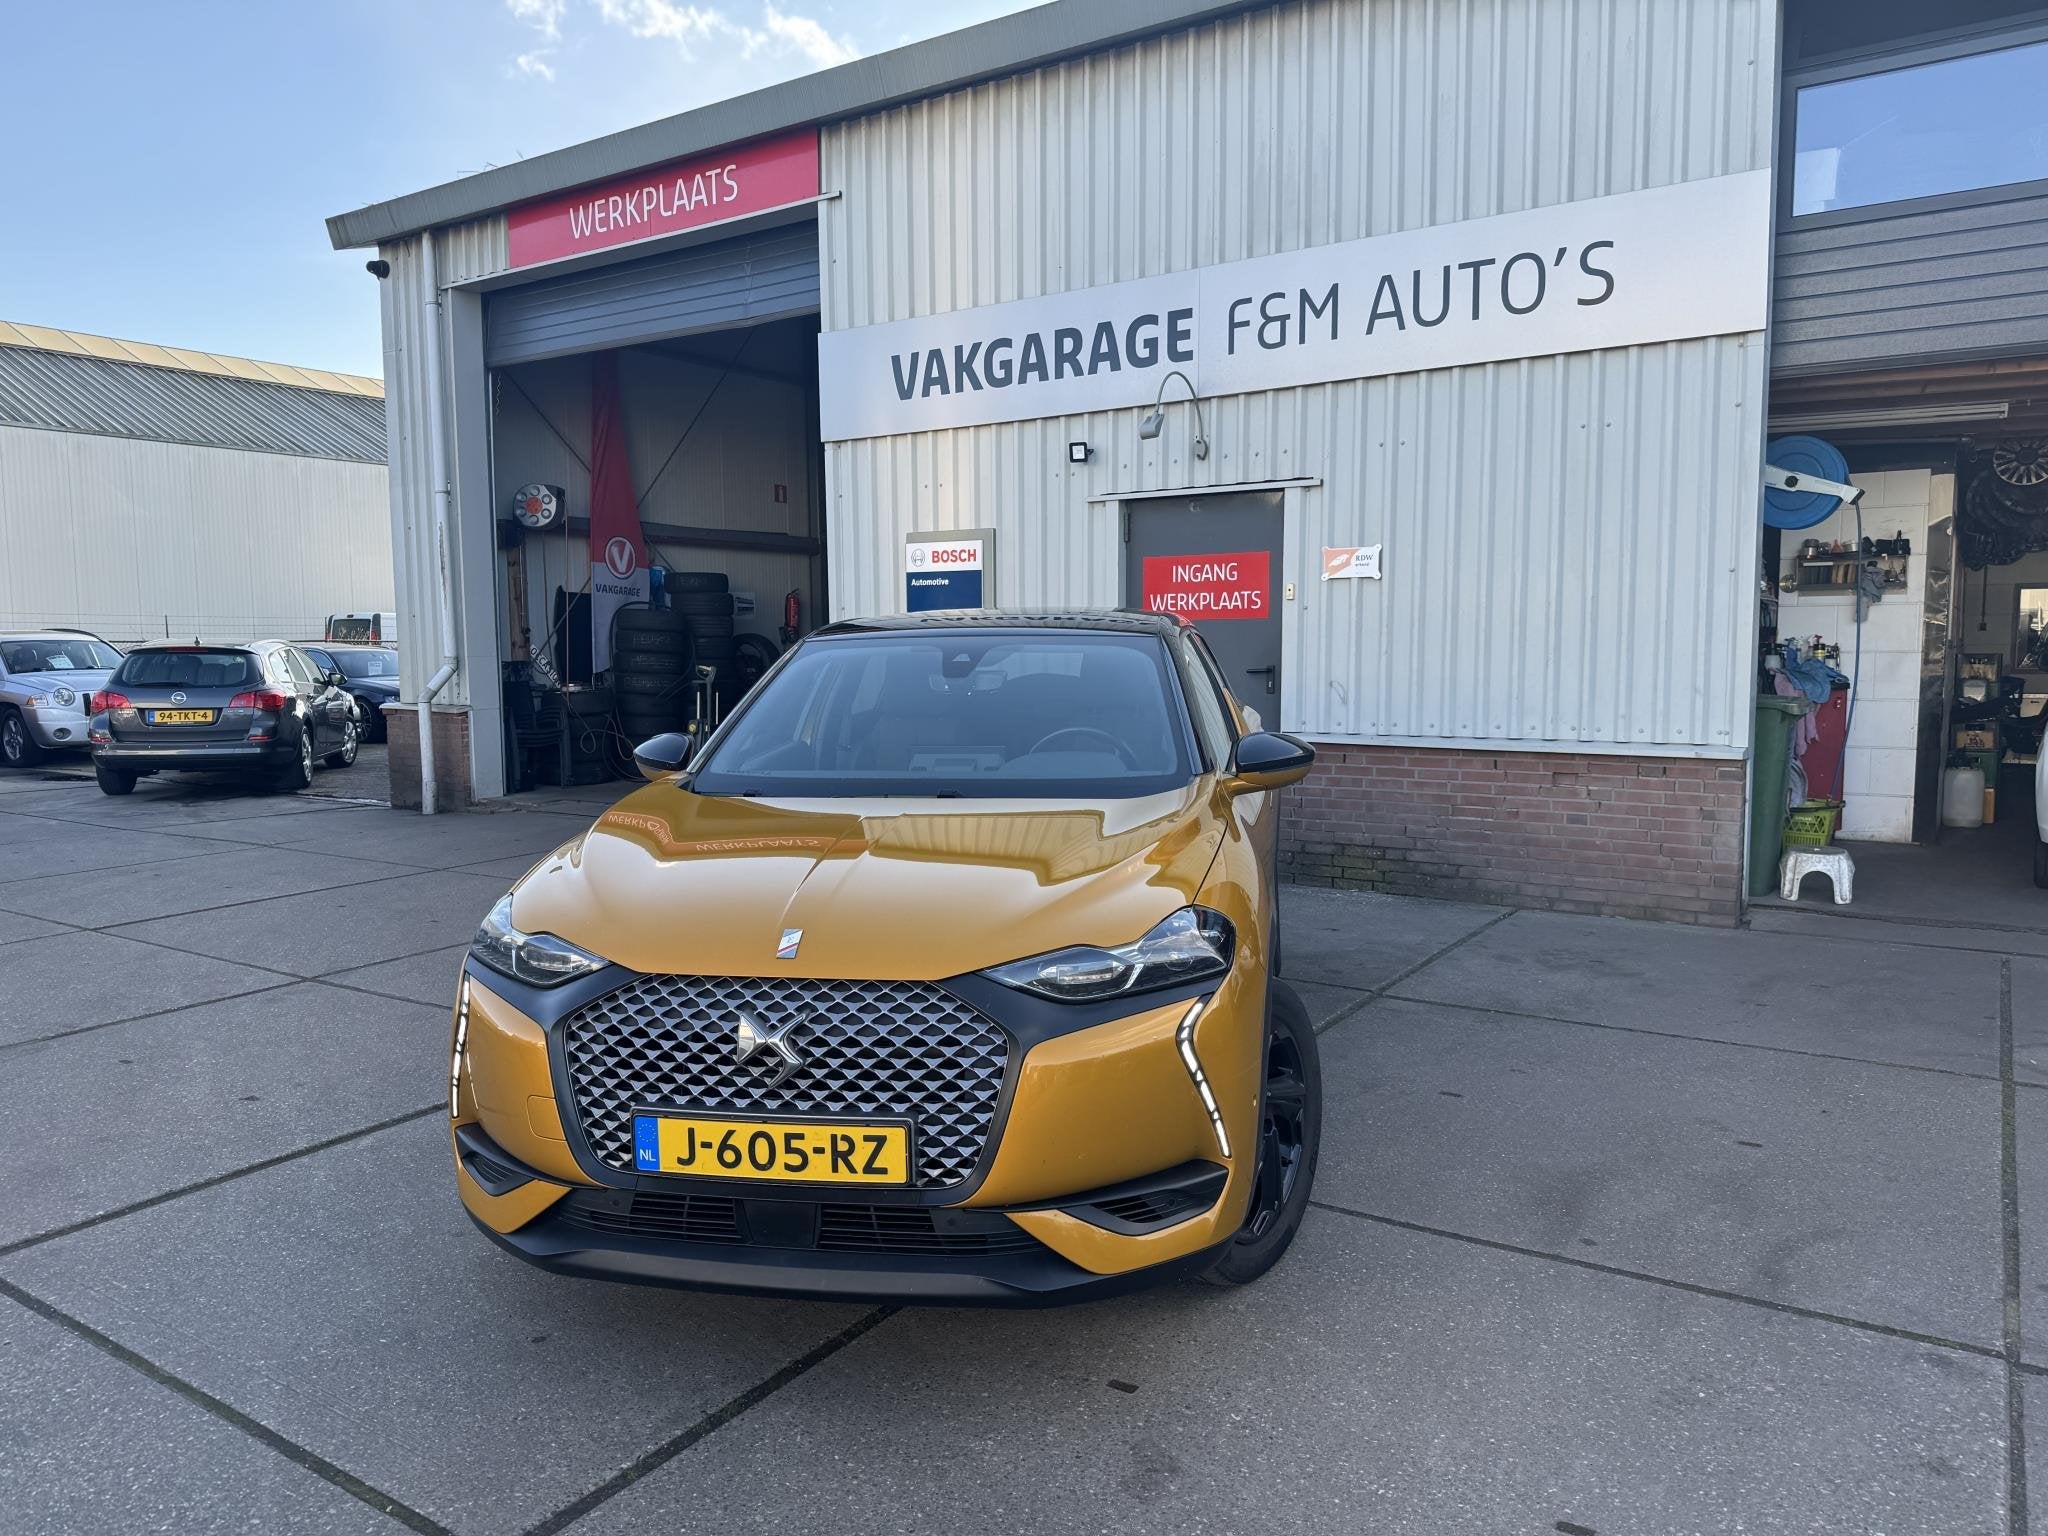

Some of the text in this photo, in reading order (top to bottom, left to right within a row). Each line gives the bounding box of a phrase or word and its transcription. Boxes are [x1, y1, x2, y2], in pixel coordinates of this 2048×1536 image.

[569, 164, 738, 239] WERKPLAATS
[890, 240, 1615, 401] VAKGARAGE F&M AUTO'S
[931, 548, 977, 563] BOSCH
[911, 578, 949, 587] Automotive
[1172, 562, 1238, 583] INGANG
[595, 583, 641, 598] VAKGARAGE
[1149, 591, 1261, 612] WERKPLAATS
[159, 711, 208, 721] 94-TKT-4
[639, 1127, 889, 1176] NL J-605-RZ
